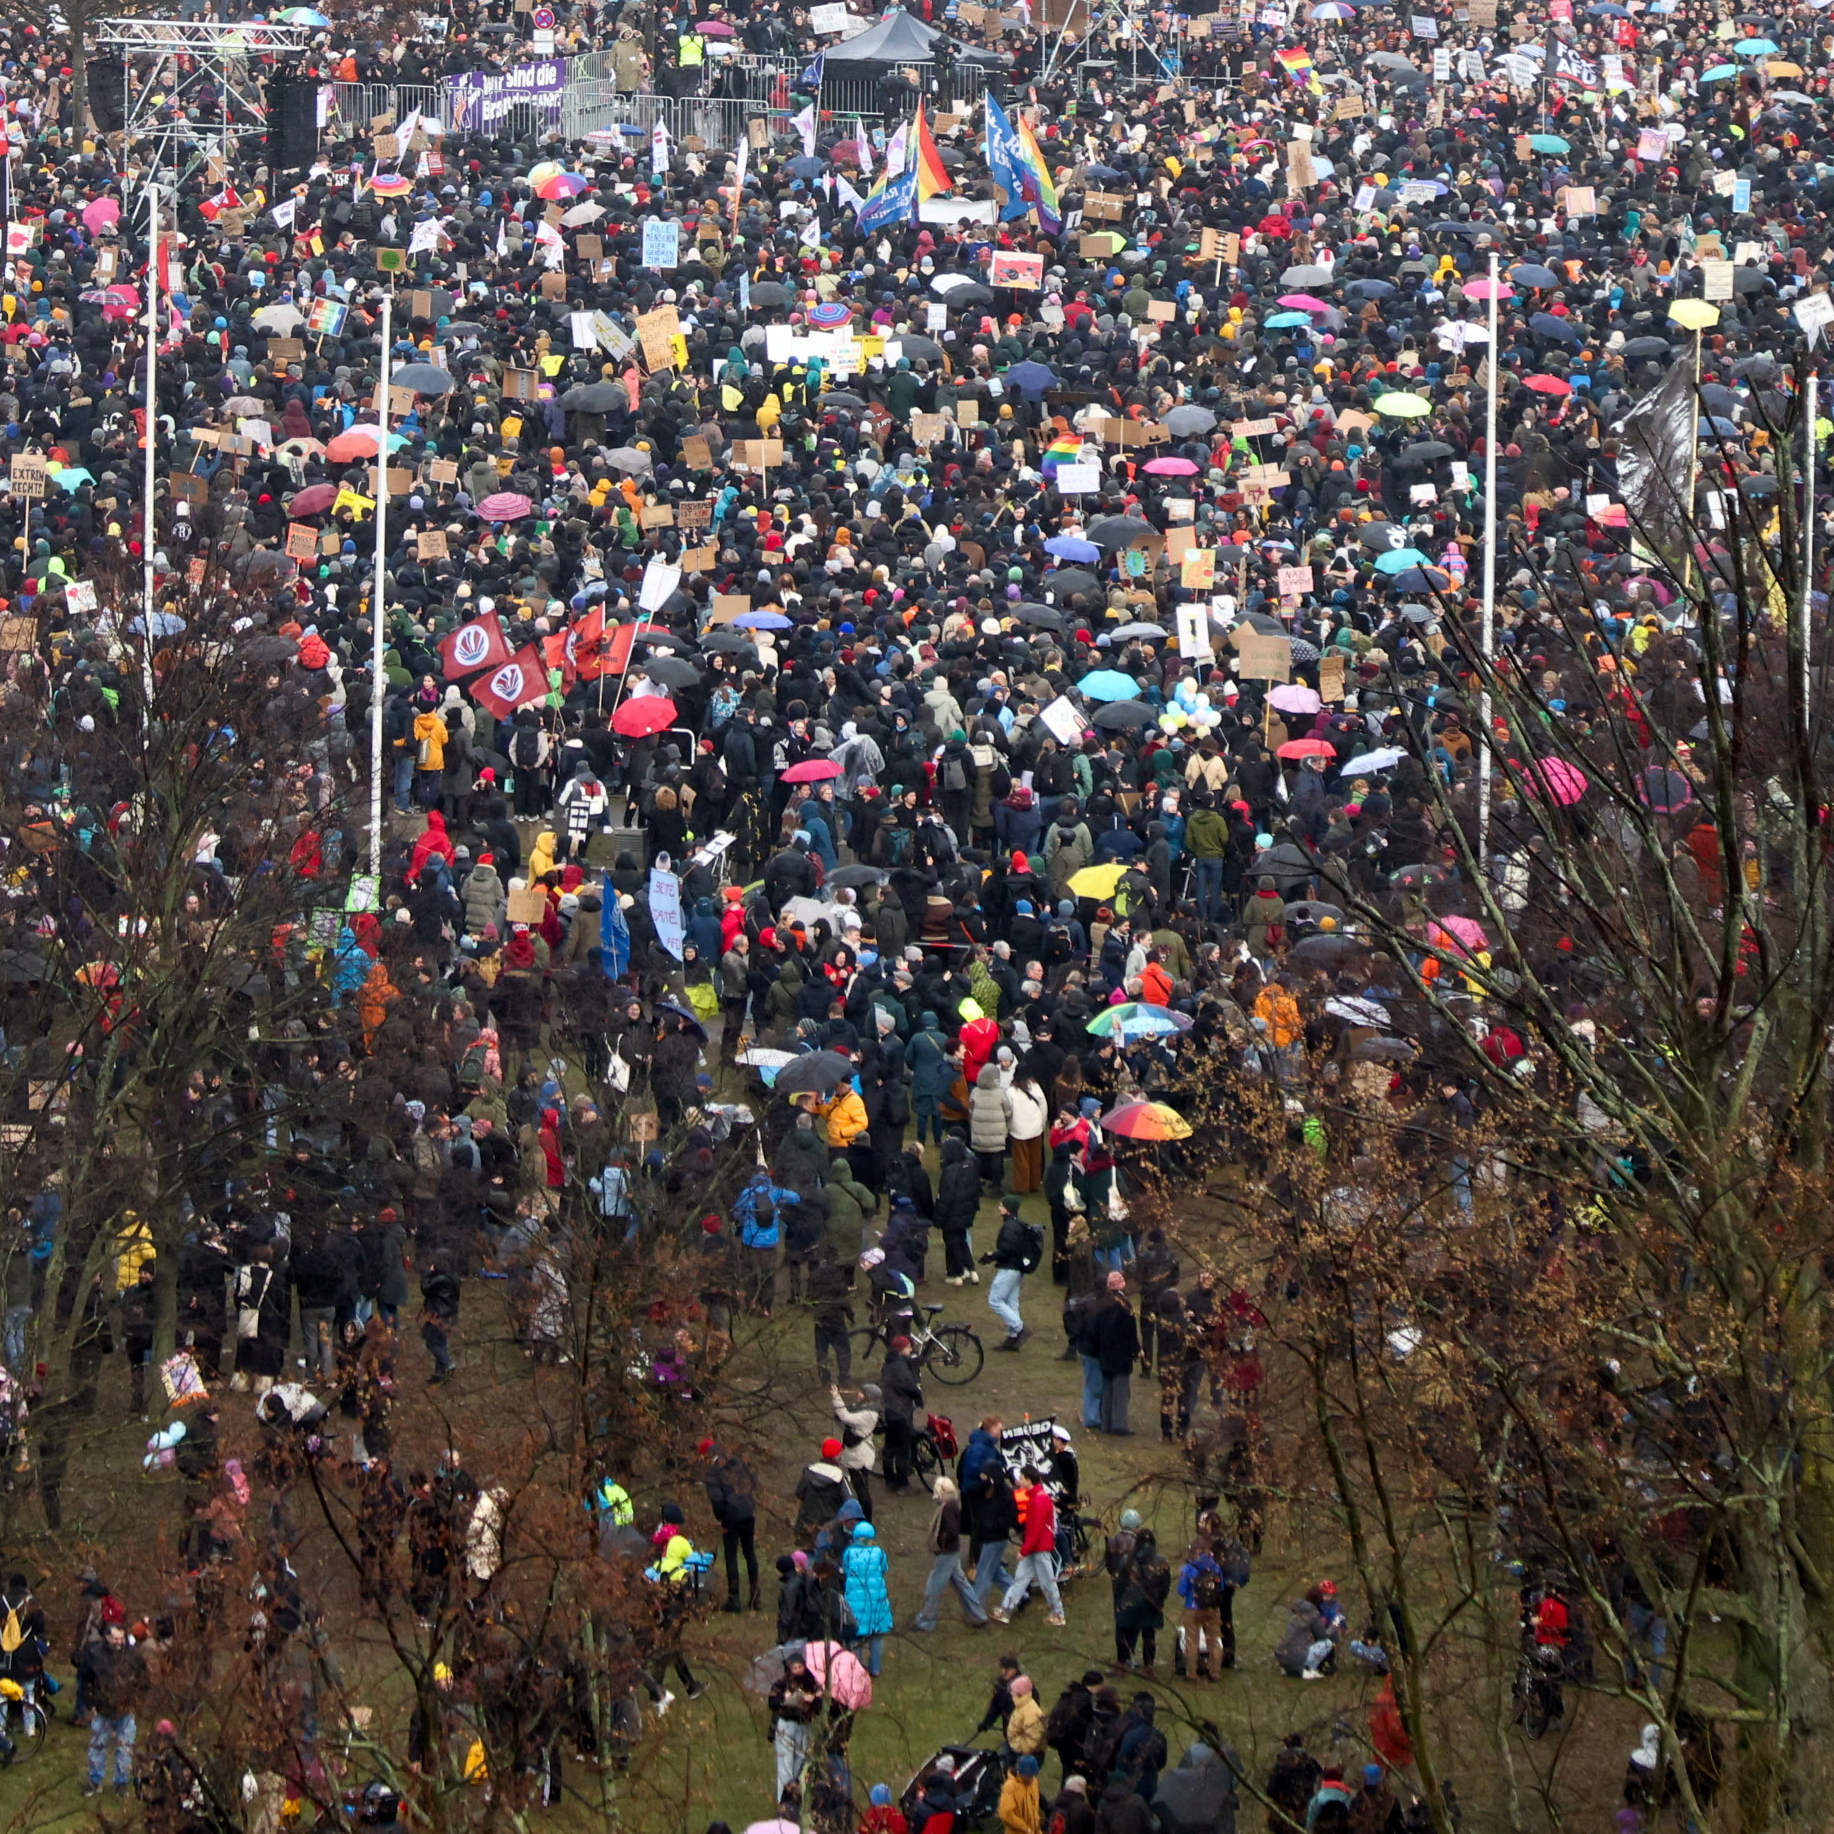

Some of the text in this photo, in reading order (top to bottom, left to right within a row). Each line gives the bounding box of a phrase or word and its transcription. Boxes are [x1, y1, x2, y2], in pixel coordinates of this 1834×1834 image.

[506, 64, 535, 88] sind
[536, 61, 557, 85] die
[1556, 59, 1597, 85] AFD
[650, 224, 670, 234] ALLE
